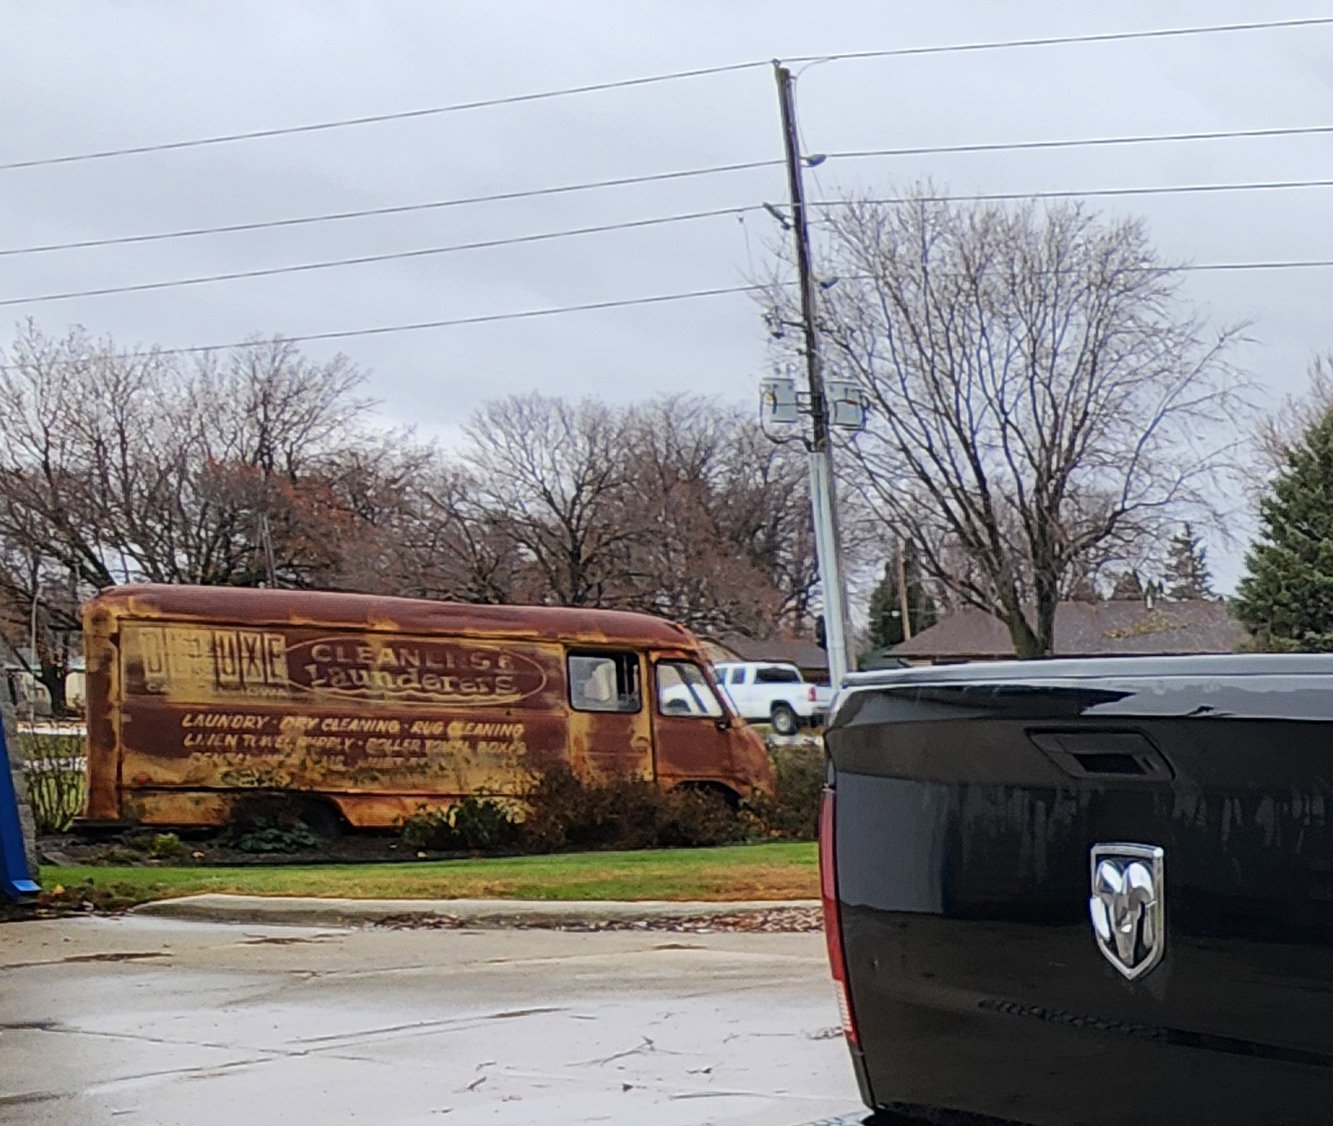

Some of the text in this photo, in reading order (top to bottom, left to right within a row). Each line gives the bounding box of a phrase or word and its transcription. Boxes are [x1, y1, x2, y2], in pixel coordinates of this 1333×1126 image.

[182, 713, 525, 738] LAUNDRY DRY CLEANING RUG CLEANING
